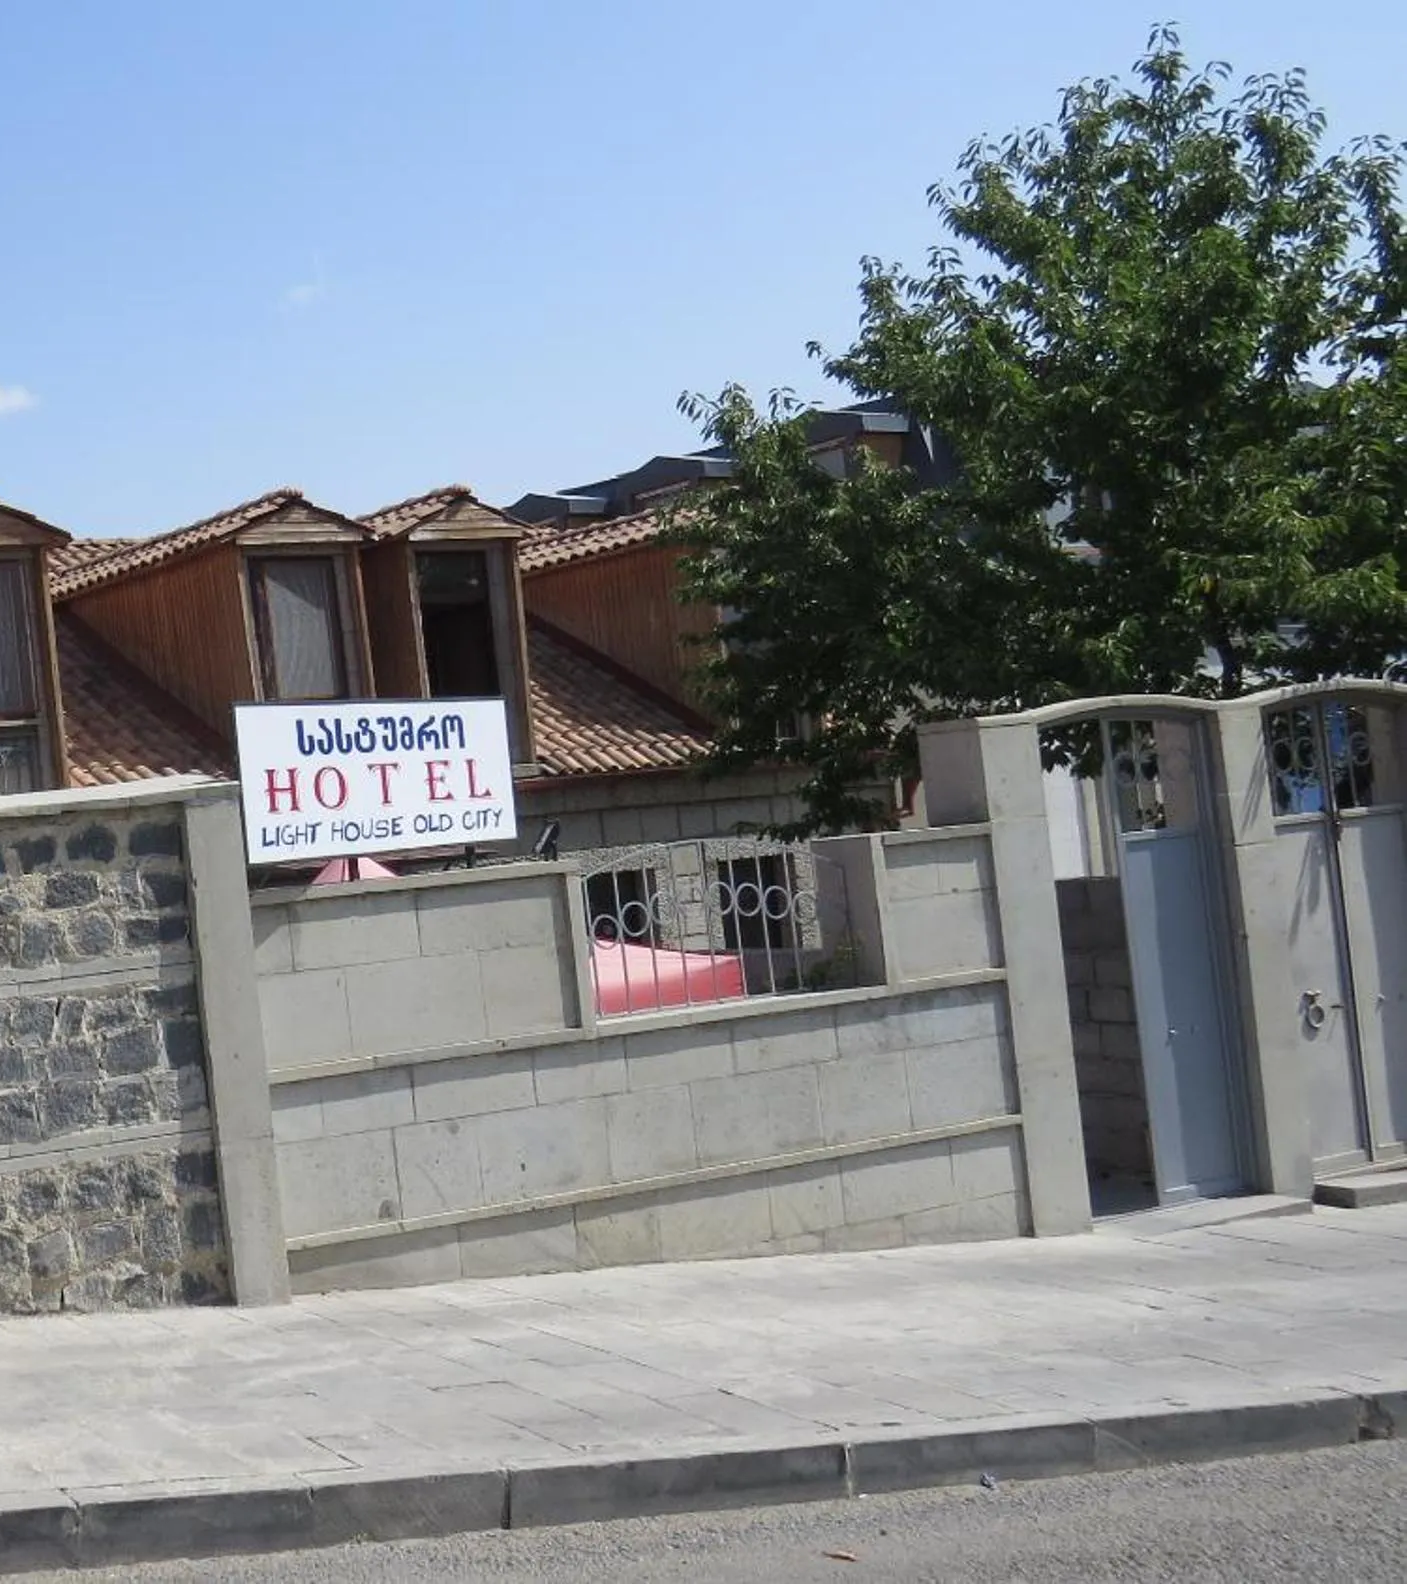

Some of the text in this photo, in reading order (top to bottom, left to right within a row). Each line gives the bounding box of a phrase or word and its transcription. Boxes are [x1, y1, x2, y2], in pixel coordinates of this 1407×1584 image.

[296, 714, 466, 756] სასტუმრო
[264, 758, 492, 814] HOTEL
[262, 808, 503, 848] LIGHT HOUSE OLD CITY
